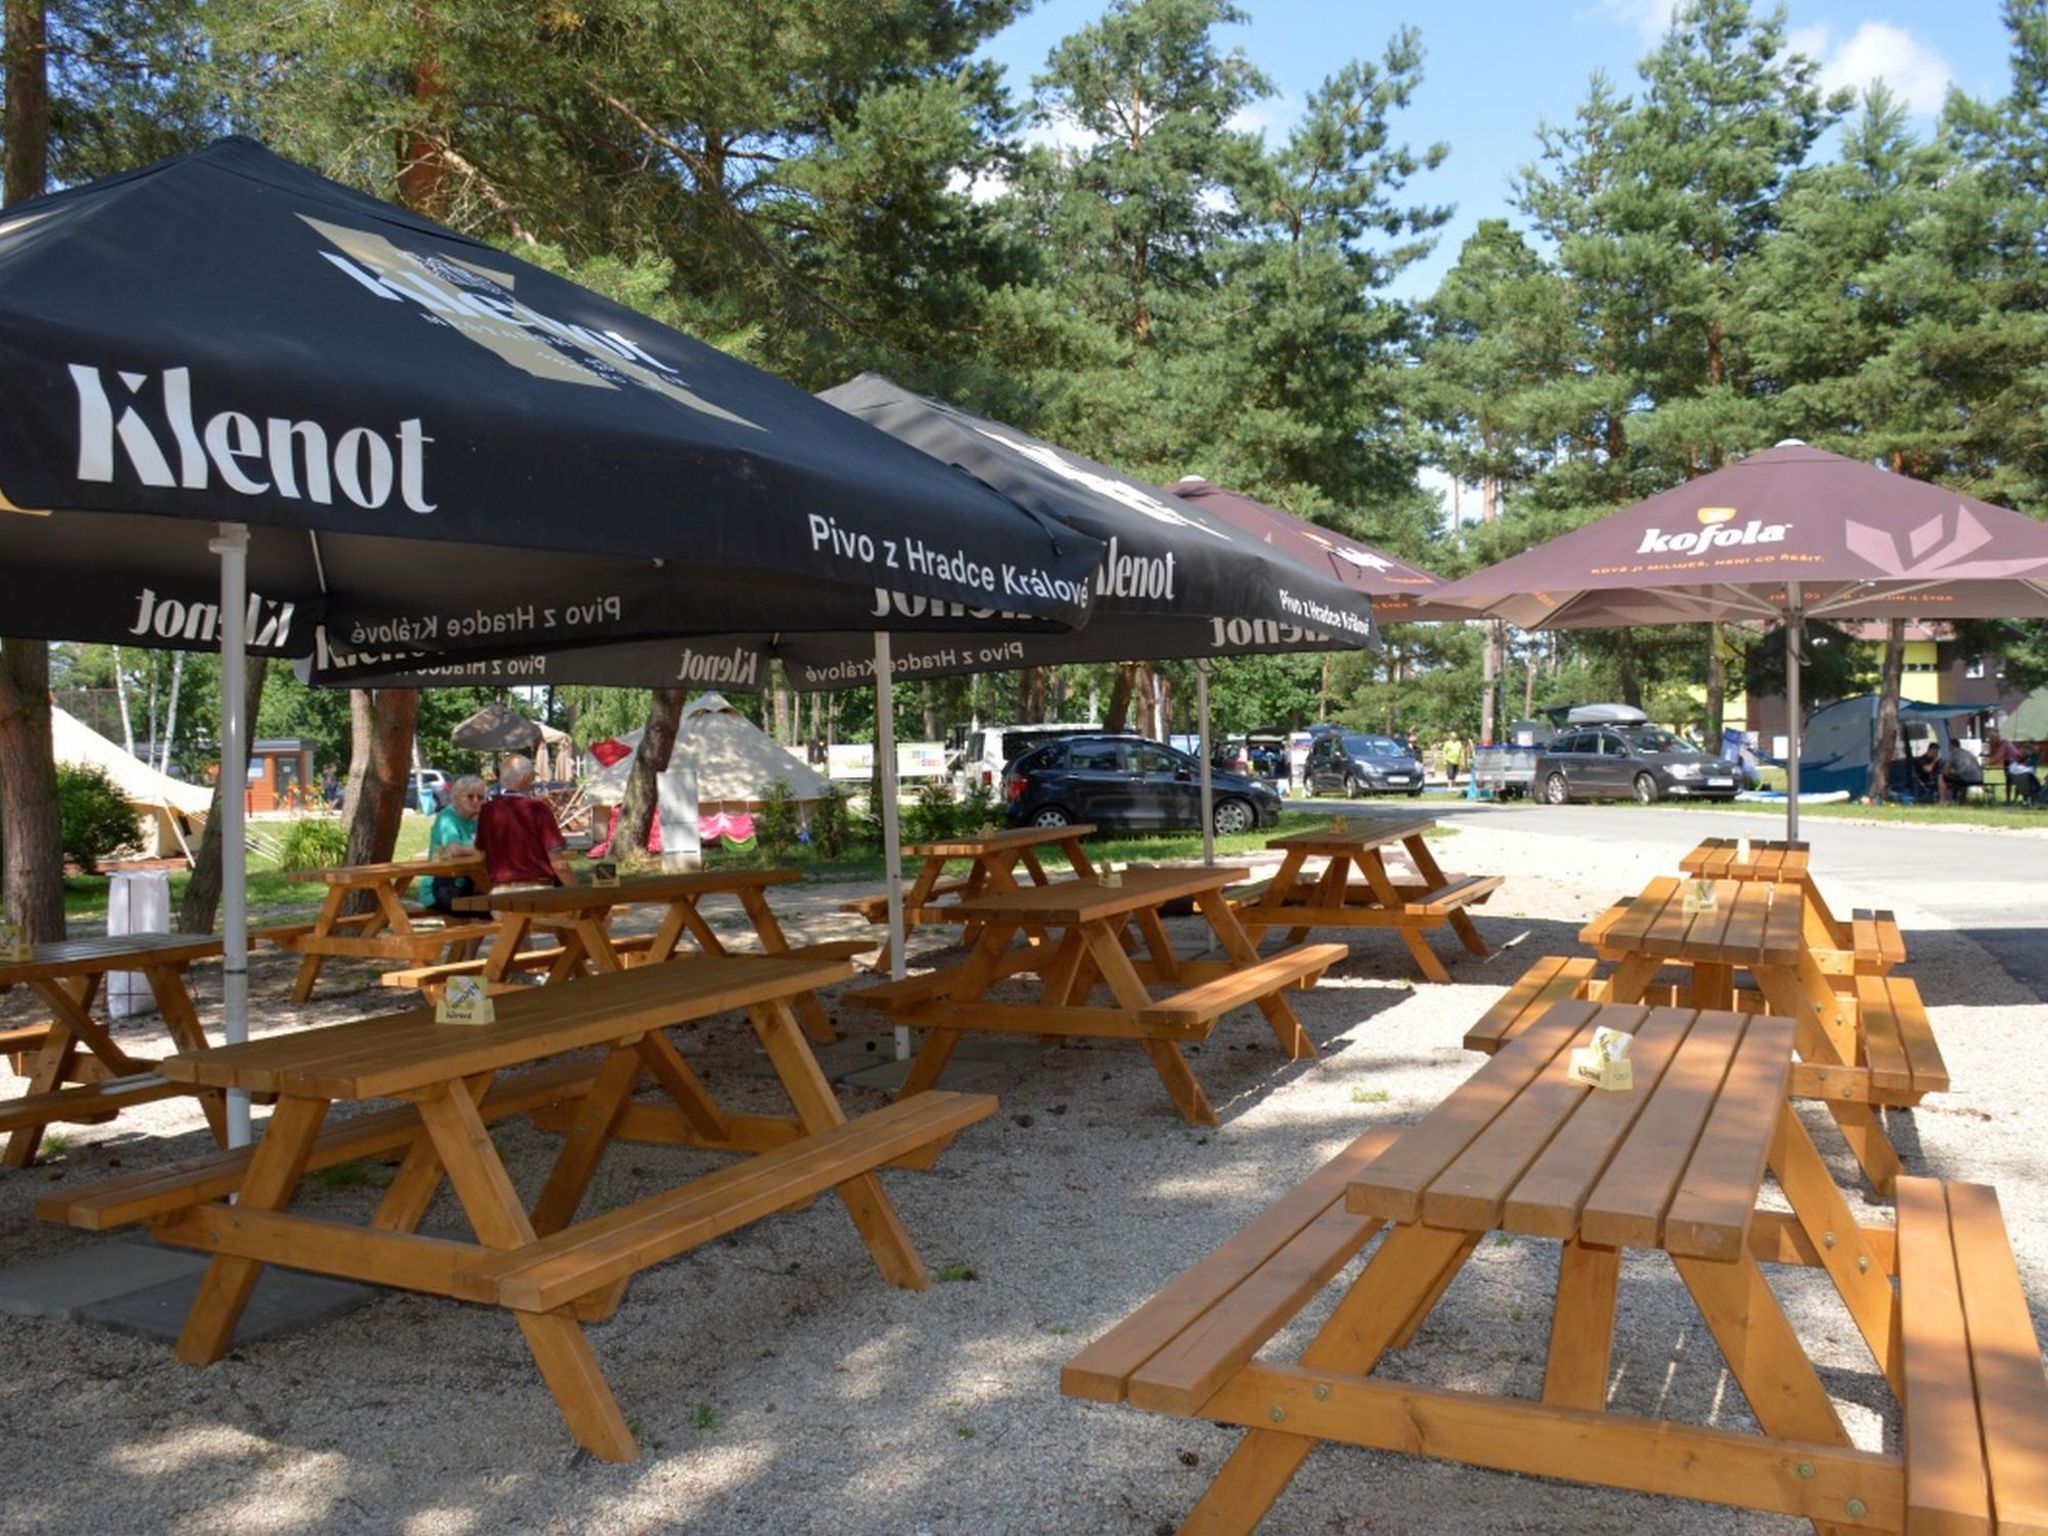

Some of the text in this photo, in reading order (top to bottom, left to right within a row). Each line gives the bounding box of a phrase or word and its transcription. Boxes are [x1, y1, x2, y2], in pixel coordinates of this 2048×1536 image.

[67, 363, 438, 514] Klenot
[808, 513, 1089, 609] Pivo z Hradce Králové
[1636, 520, 1786, 556] kofola
